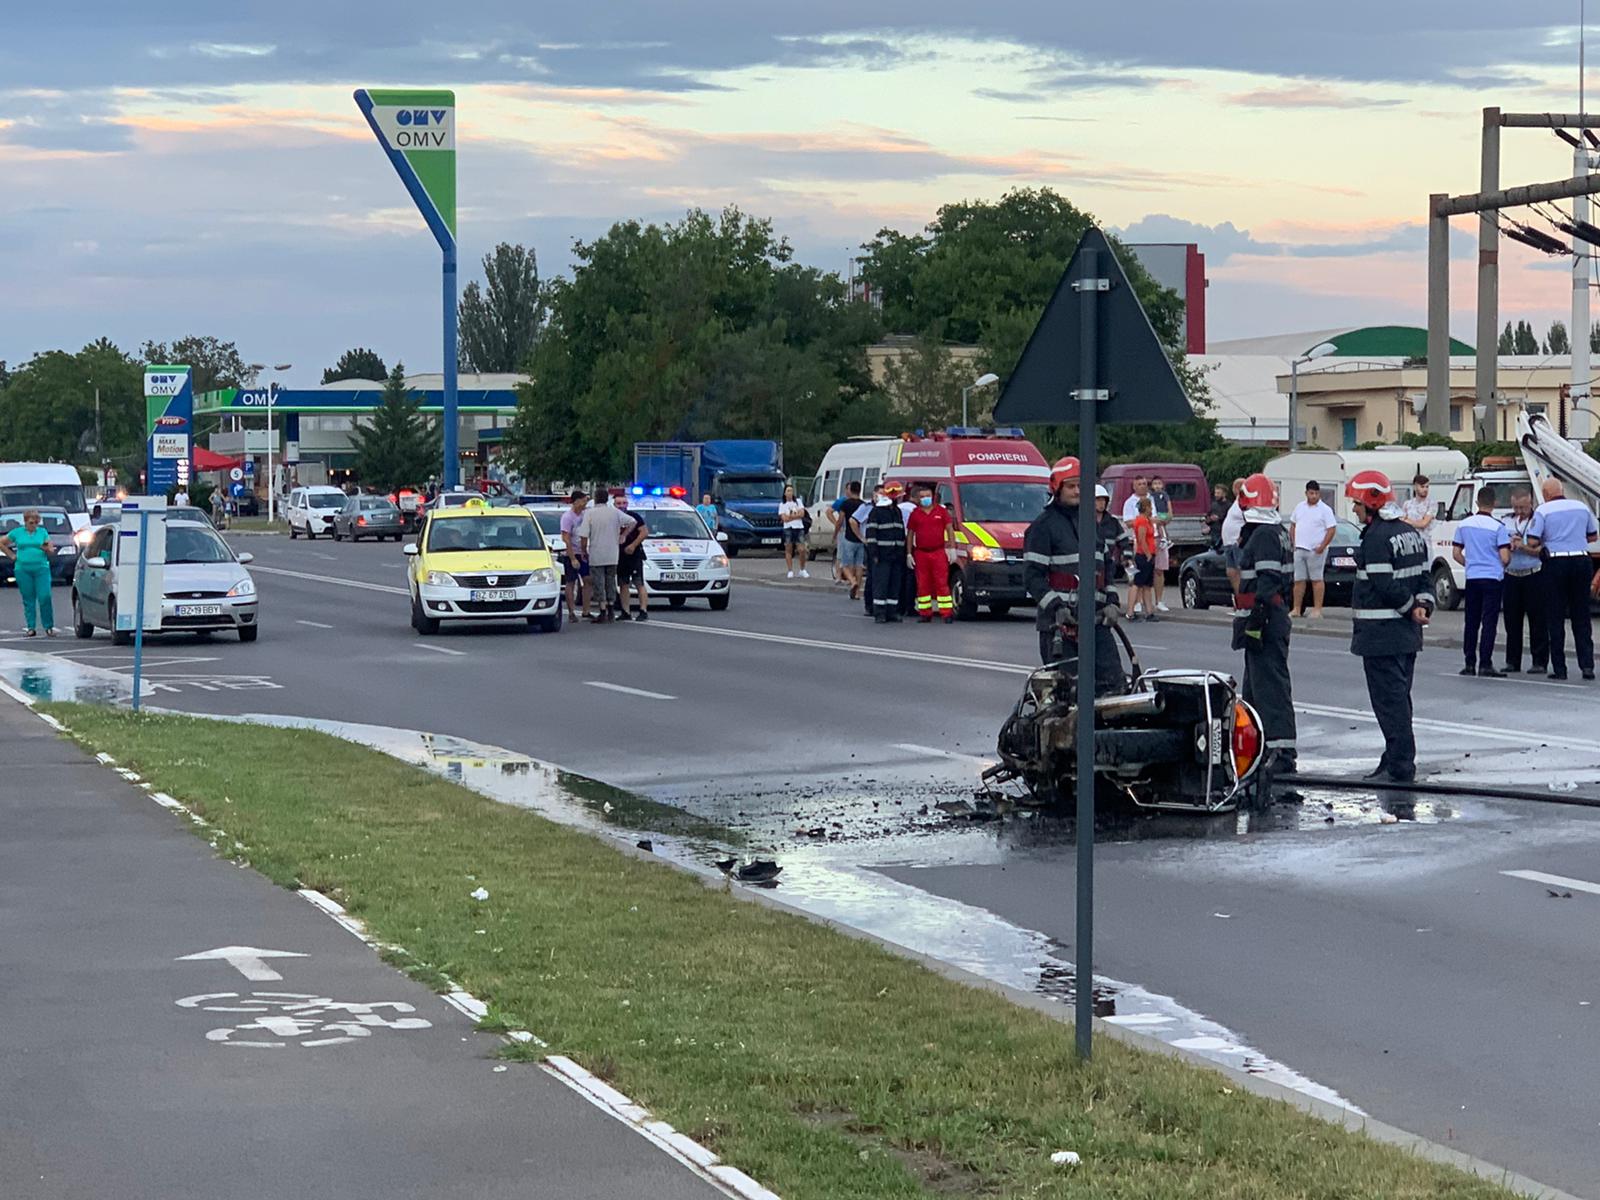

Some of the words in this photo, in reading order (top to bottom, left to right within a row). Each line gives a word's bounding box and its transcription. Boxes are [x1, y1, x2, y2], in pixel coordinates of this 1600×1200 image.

[397, 110, 446, 125] OMV
[397, 132, 446, 147] OMV
[151, 386, 177, 394] OMV
[242, 393, 279, 405] OMV
[157, 445, 185, 453] Motion
[968, 453, 1028, 462] POMPIERII
